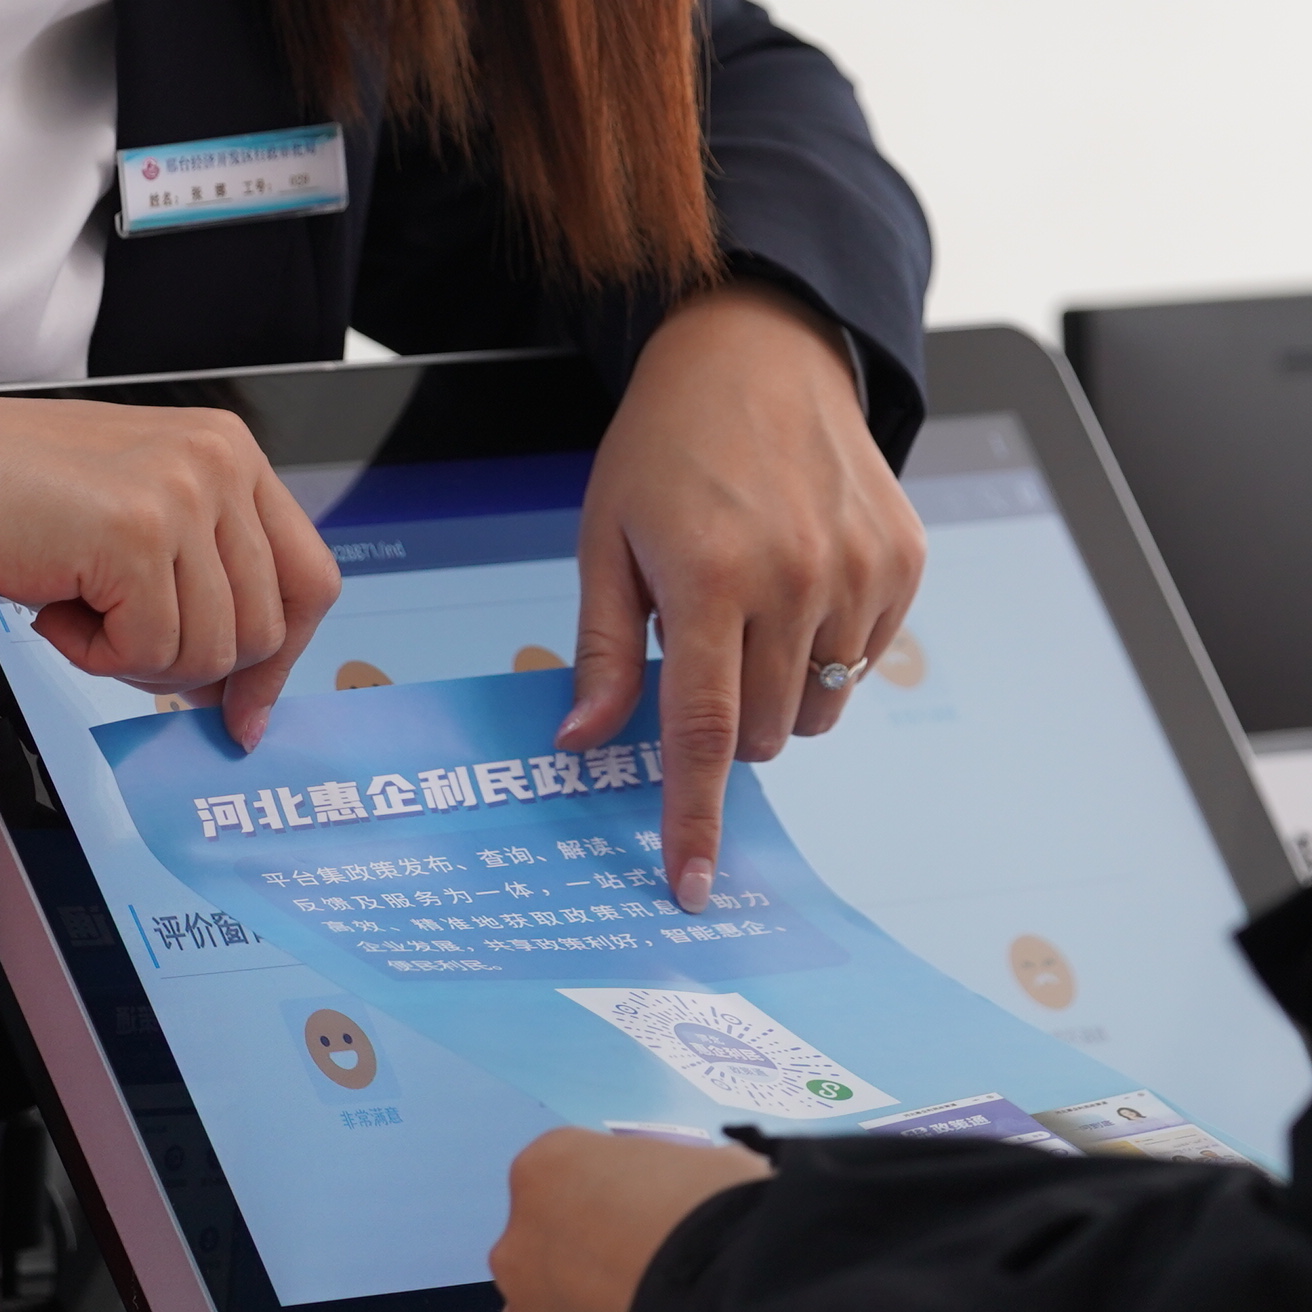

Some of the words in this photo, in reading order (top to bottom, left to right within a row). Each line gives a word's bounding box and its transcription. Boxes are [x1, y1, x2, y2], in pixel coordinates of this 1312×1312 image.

[152, 911, 265, 951] 评价窗
[340, 1107, 404, 1129] 非常满意
